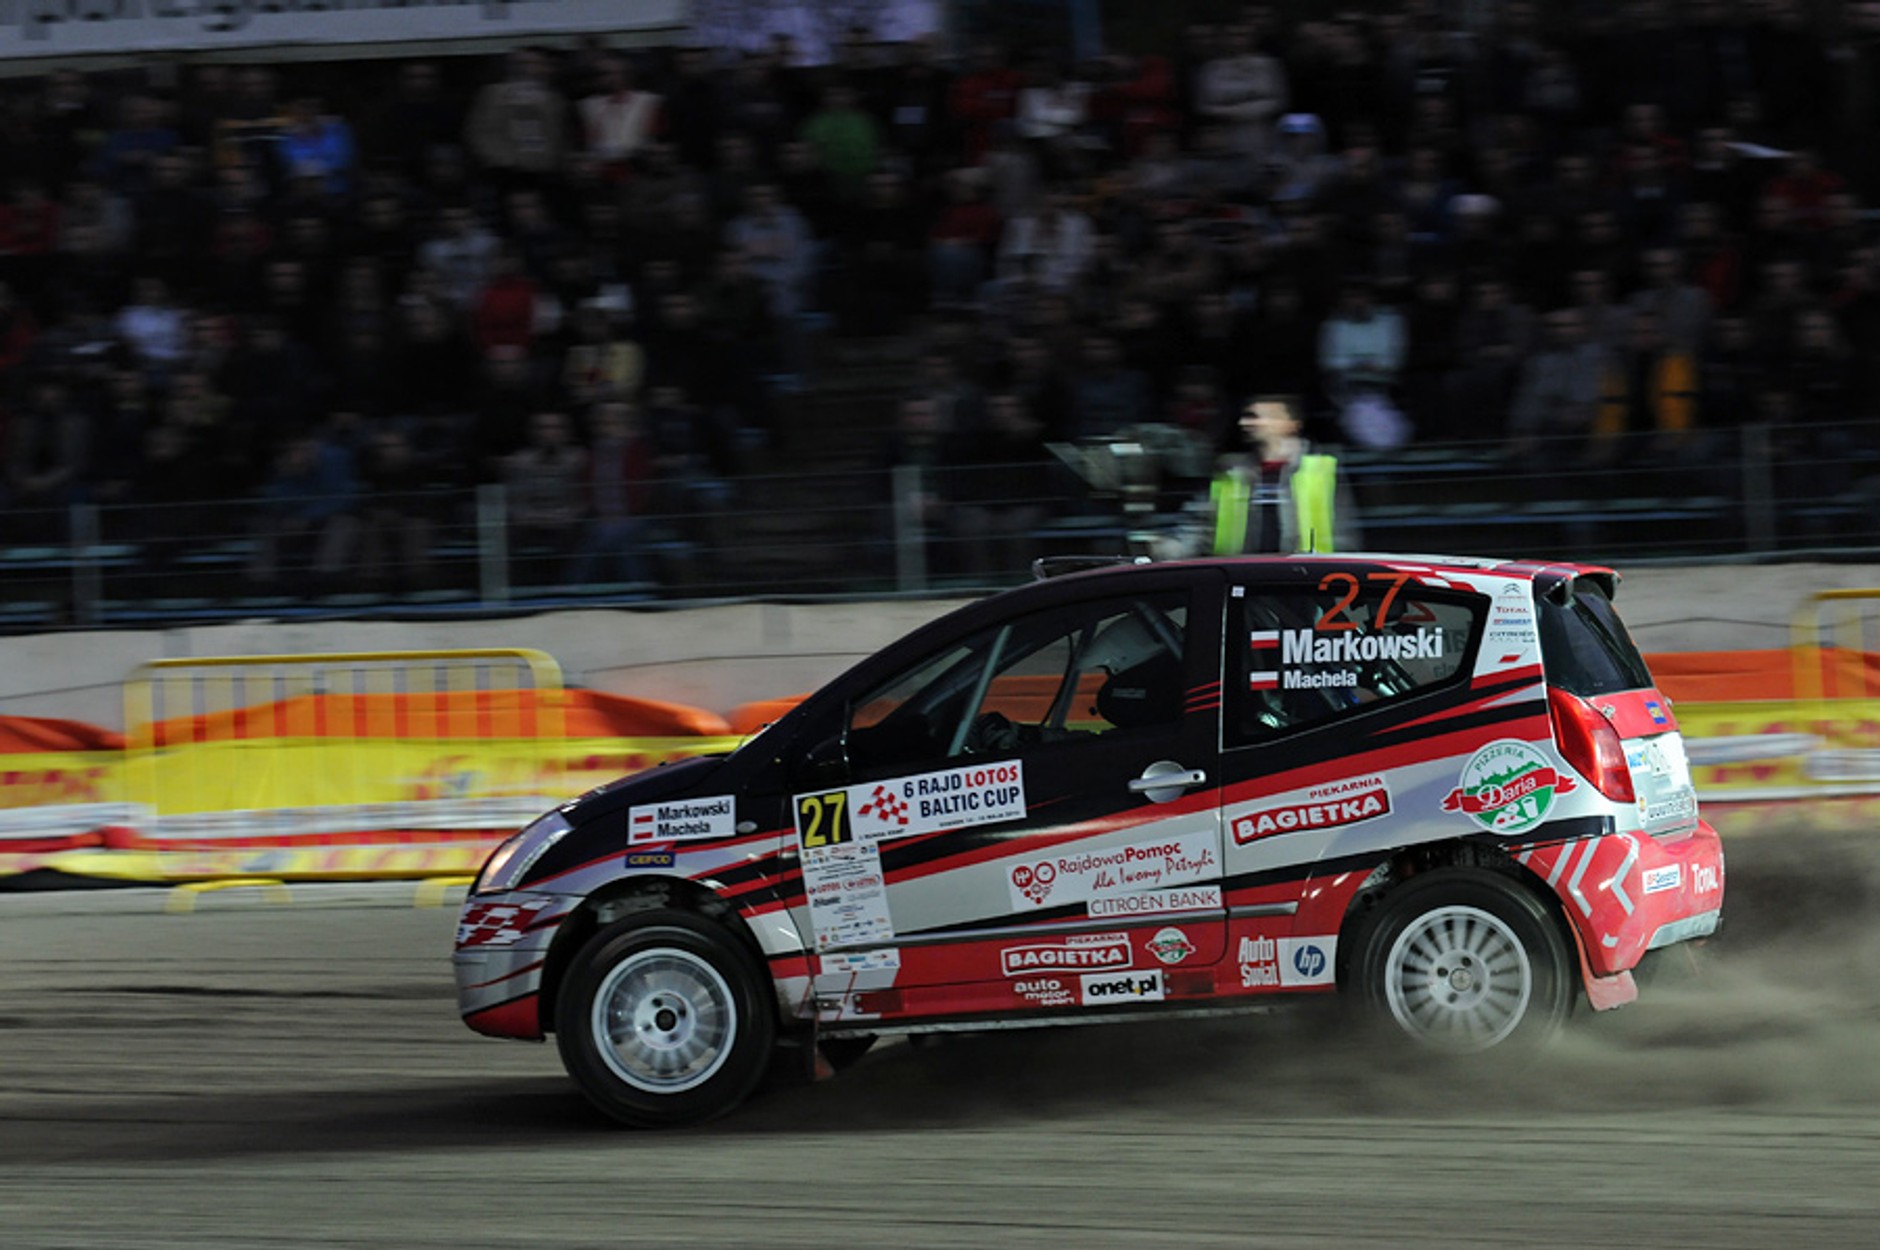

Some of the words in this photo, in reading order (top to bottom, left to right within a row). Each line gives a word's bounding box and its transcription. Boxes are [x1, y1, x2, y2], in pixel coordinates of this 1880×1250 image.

[1314, 572, 1411, 631] 27
[1282, 627, 1443, 665] Markowski
[1283, 669, 1357, 690] Machela
[1474, 746, 1525, 772] PIZZERIA
[903, 781, 914, 799] 6
[918, 774, 962, 796] RAJD
[965, 765, 1018, 788] LOTOS
[1309, 777, 1383, 799] PIEKARNIA
[1477, 777, 1537, 811] Daria
[658, 800, 730, 821] Markowski
[920, 792, 979, 818] BALTIC
[983, 786, 1020, 808] CUP
[658, 820, 711, 837] Machela
[801, 792, 846, 848] 27
[1237, 796, 1382, 839] BAGIETKA
[629, 855, 672, 865] GEFCO
[1092, 872, 1116, 891] dla
[1090, 895, 1164, 915] CITROËN
[1169, 890, 1217, 908] BANK
[1067, 934, 1126, 945] PIEKARNIA
[1239, 935, 1275, 962] Auto
[1008, 948, 1124, 968] BAGIETKA
[1297, 945, 1324, 977] hp
[1014, 979, 1061, 993] auto
[1088, 975, 1158, 997] onet.pl
